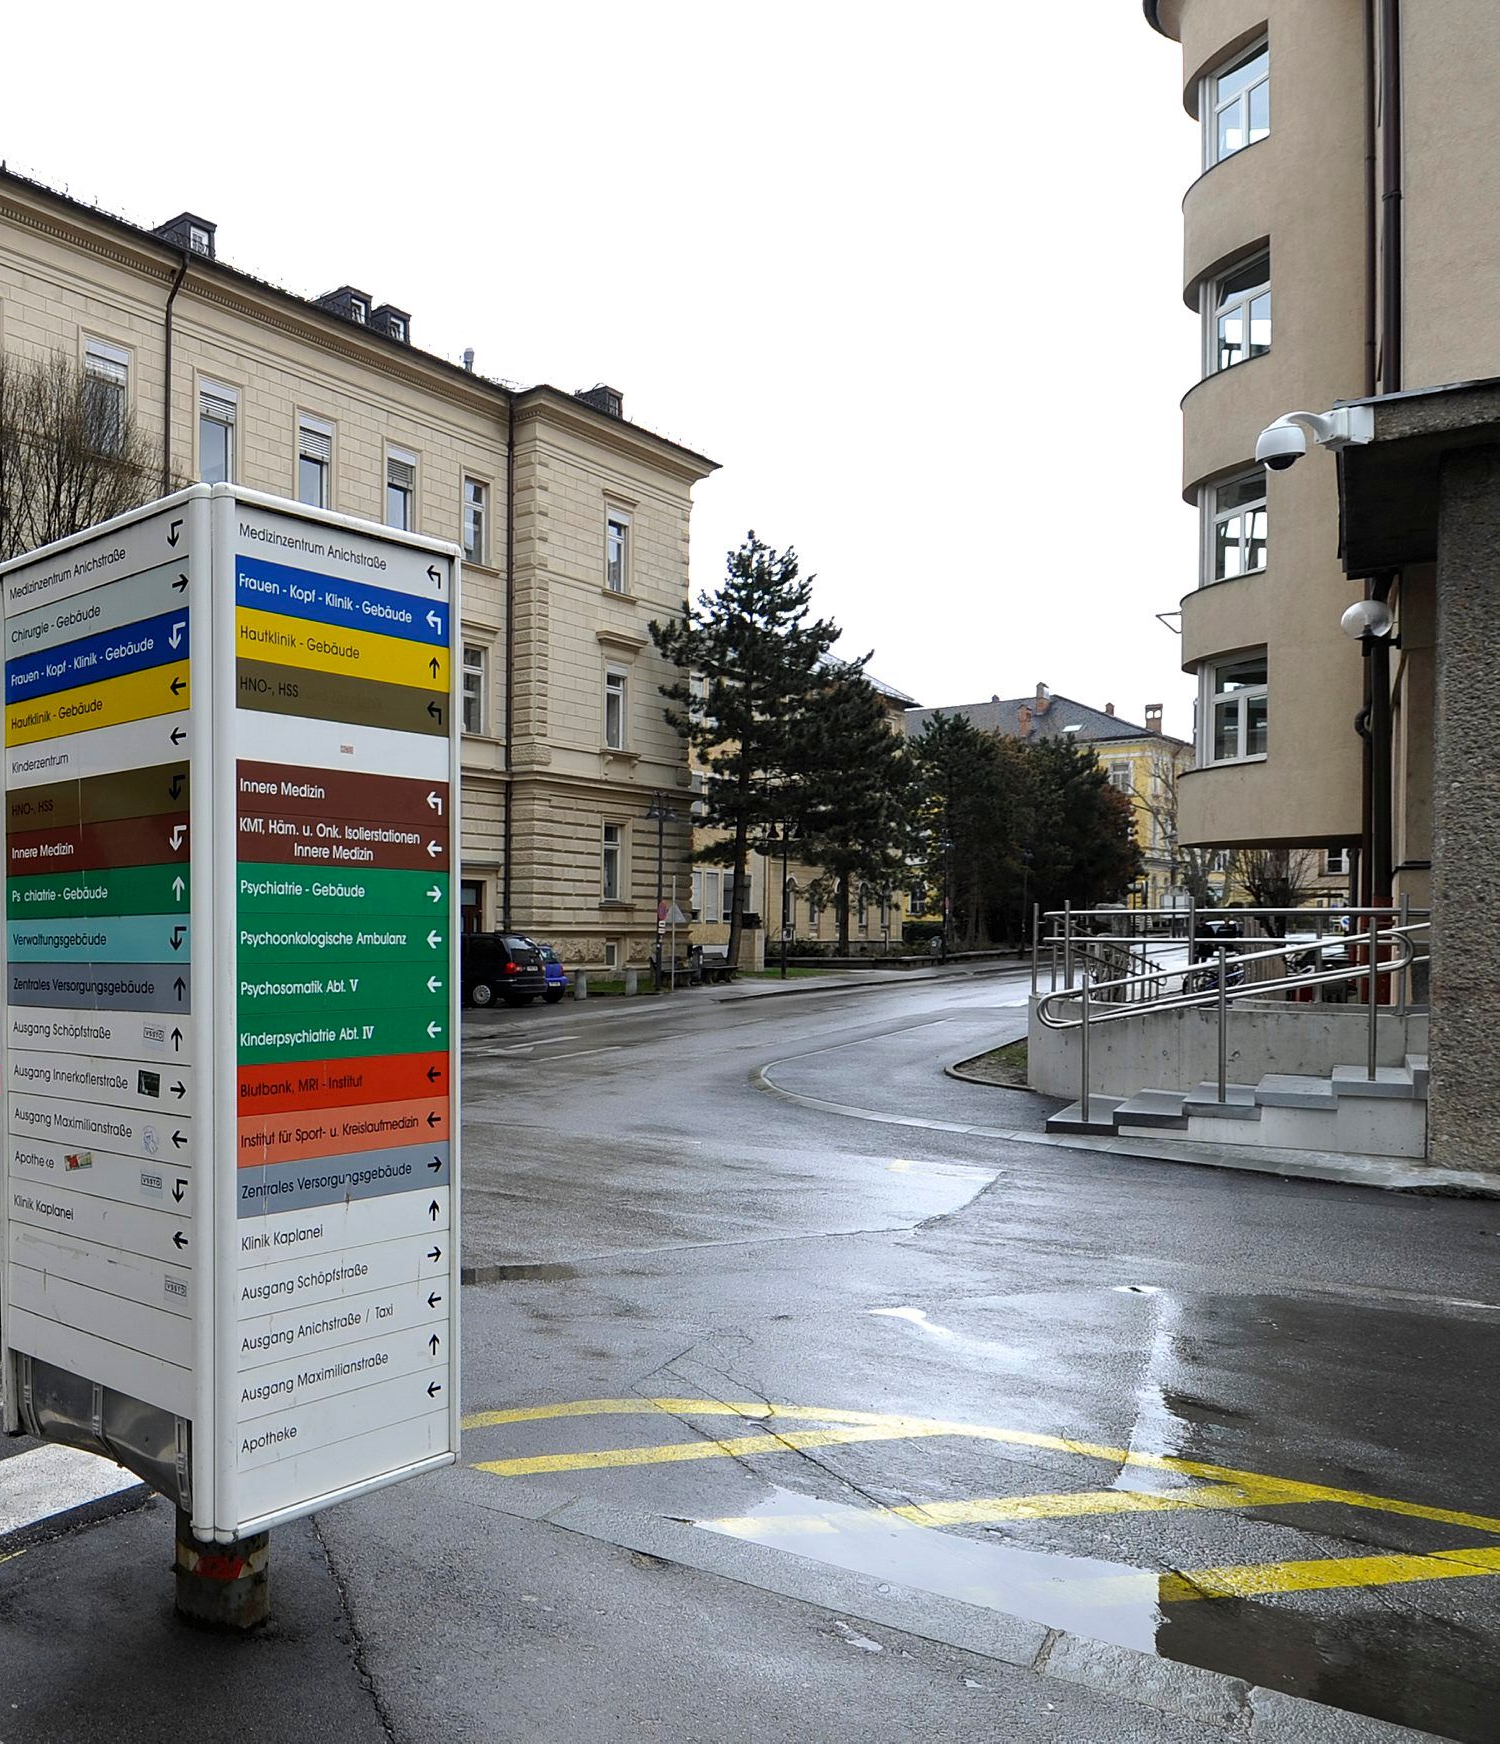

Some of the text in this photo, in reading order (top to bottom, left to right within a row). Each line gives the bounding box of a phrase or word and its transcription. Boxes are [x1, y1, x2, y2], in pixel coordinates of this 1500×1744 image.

[239, 523, 387, 571] Medizinzentrum Anichstraße
[9, 548, 126, 600] Medizinzentrum Anichstraße
[239, 573, 280, 595] Frauen
[289, 584, 316, 603] Kopf
[325, 592, 353, 611] Klinik
[362, 600, 412, 623] Gebäude
[11, 621, 49, 643] Chirurgie
[56, 605, 101, 628] Gebäude
[240, 625, 297, 648] Hautklinik
[306, 637, 360, 660] Gebäude
[11, 670, 40, 687] Frauen
[46, 658, 67, 678] Kopf
[73, 653, 97, 669] Klinik
[105, 637, 154, 661] Gebäude
[239, 677, 299, 697] HNO-, HSS
[11, 711, 51, 730] Hautklinik
[58, 699, 103, 719] Gebäude
[11, 752, 69, 774] Kinderzentrum
[240, 778, 325, 799] Innere Medizin
[38, 799, 54, 813] HSS
[239, 817, 421, 844] KMT, Häm. u. Onk. Isolierstationen
[11, 842, 74, 859] Innere Medizin
[294, 843, 374, 861] Innere Medizin
[11, 888, 56, 903] Pschiatrie
[62, 885, 108, 900] Gebäude
[240, 879, 302, 897] Psychiatrie
[312, 882, 365, 898] Gebäude
[12, 933, 107, 948] Verwaltungsgebäude
[240, 931, 407, 948] Psychoonkologische Ambulanz
[13, 977, 155, 996] Zentrales Versorgungsgebäude
[240, 979, 359, 998] Psychosomatik Abt. V
[12, 1021, 111, 1040] Ausgang Schöpfstraße
[240, 1026, 375, 1047] Kinderpsychiatrie Abt. IV
[13, 1064, 129, 1090] Ausgang Innerkoflerstraße
[240, 1080, 295, 1098] Blutbank,
[298, 1078, 319, 1091] MRI
[328, 1075, 363, 1090] Institut
[14, 1108, 133, 1138] Ausgang Maximilianstraße
[241, 1116, 419, 1148] Institut für Sport- u. Kreislaufmedizin
[241, 1163, 412, 1199] Zentrales Versorgungsgebäude
[13, 1194, 35, 1211] Klinik
[35, 1199, 74, 1220] Kaplanei
[241, 1224, 323, 1251] Klinik Kaplanei
[241, 1263, 368, 1301] Ausgang Schöpfstraße
[241, 1329, 294, 1352] Ausgang
[297, 1312, 361, 1337] Anichstraße
[375, 1304, 393, 1319] Taxi
[241, 1352, 388, 1402] Ausgang Maximilianstraße
[241, 1426, 297, 1453] Apotheke
